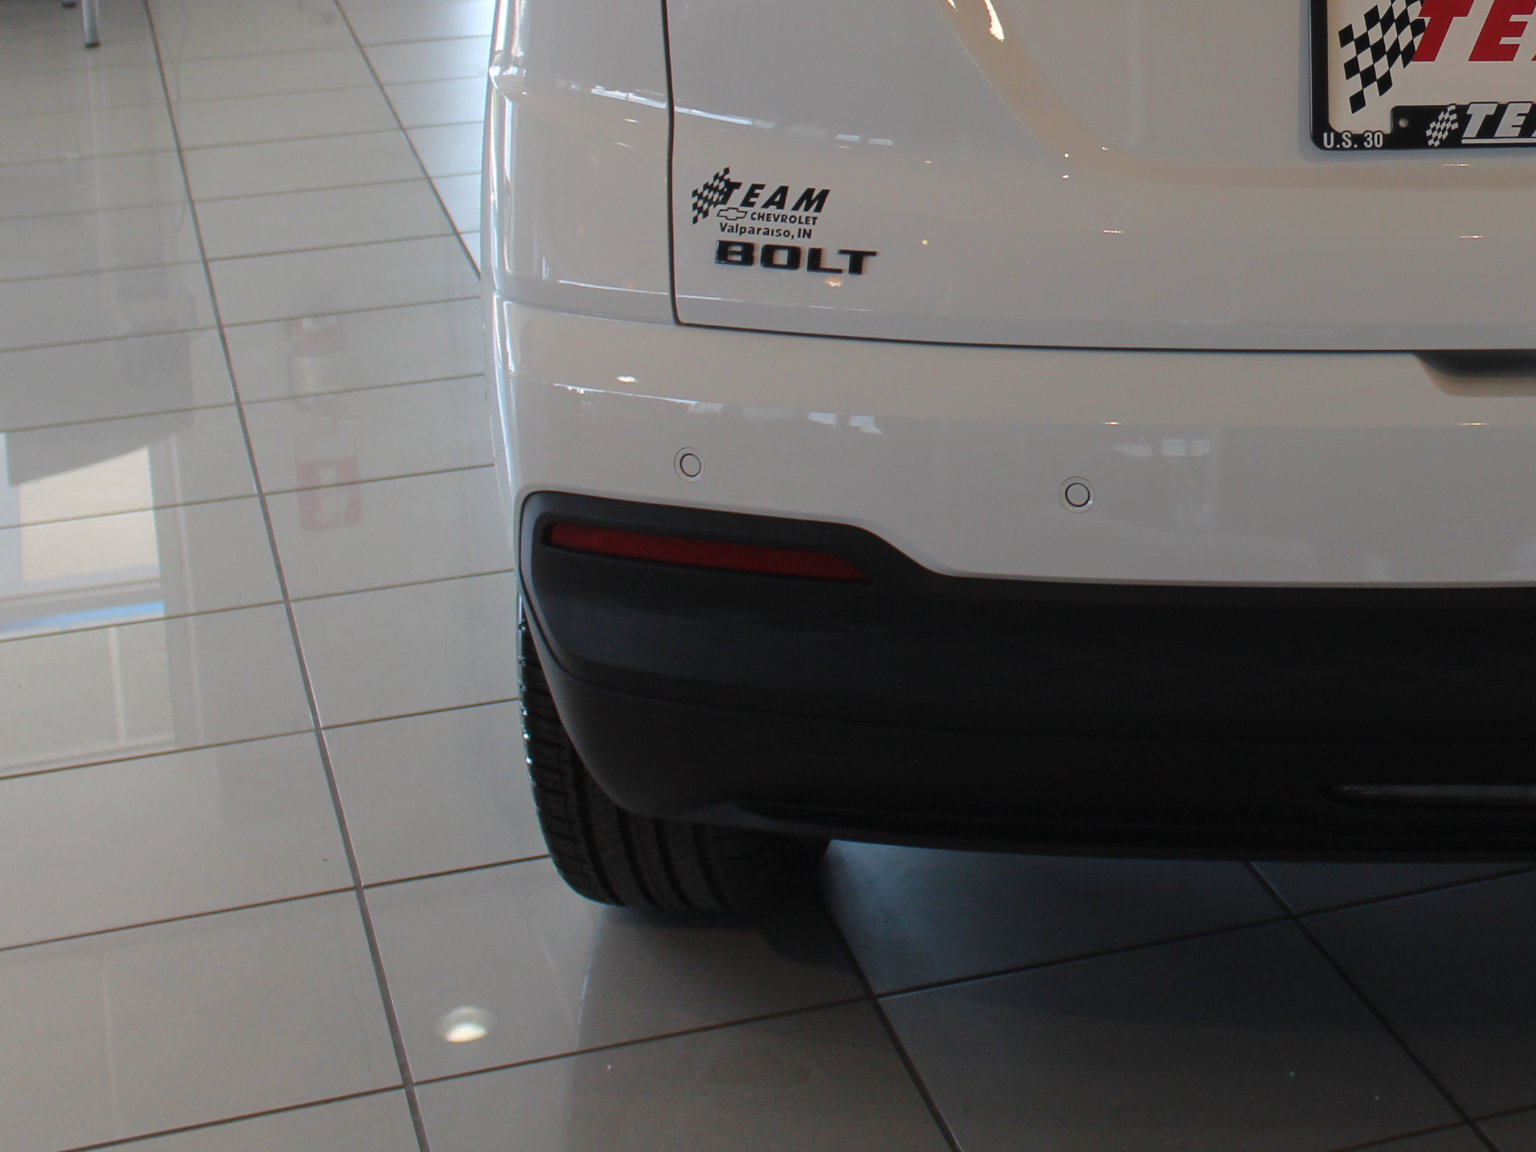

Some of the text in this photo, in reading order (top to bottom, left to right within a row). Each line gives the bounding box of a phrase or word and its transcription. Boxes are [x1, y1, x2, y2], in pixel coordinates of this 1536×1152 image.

[1323, 131, 1384, 148] U.S. 30
[718, 181, 831, 214] TEAM
[750, 211, 819, 226] CHEVROLET
[719, 222, 813, 240] Valparaiso, IN
[715, 240, 878, 275] BOLT
